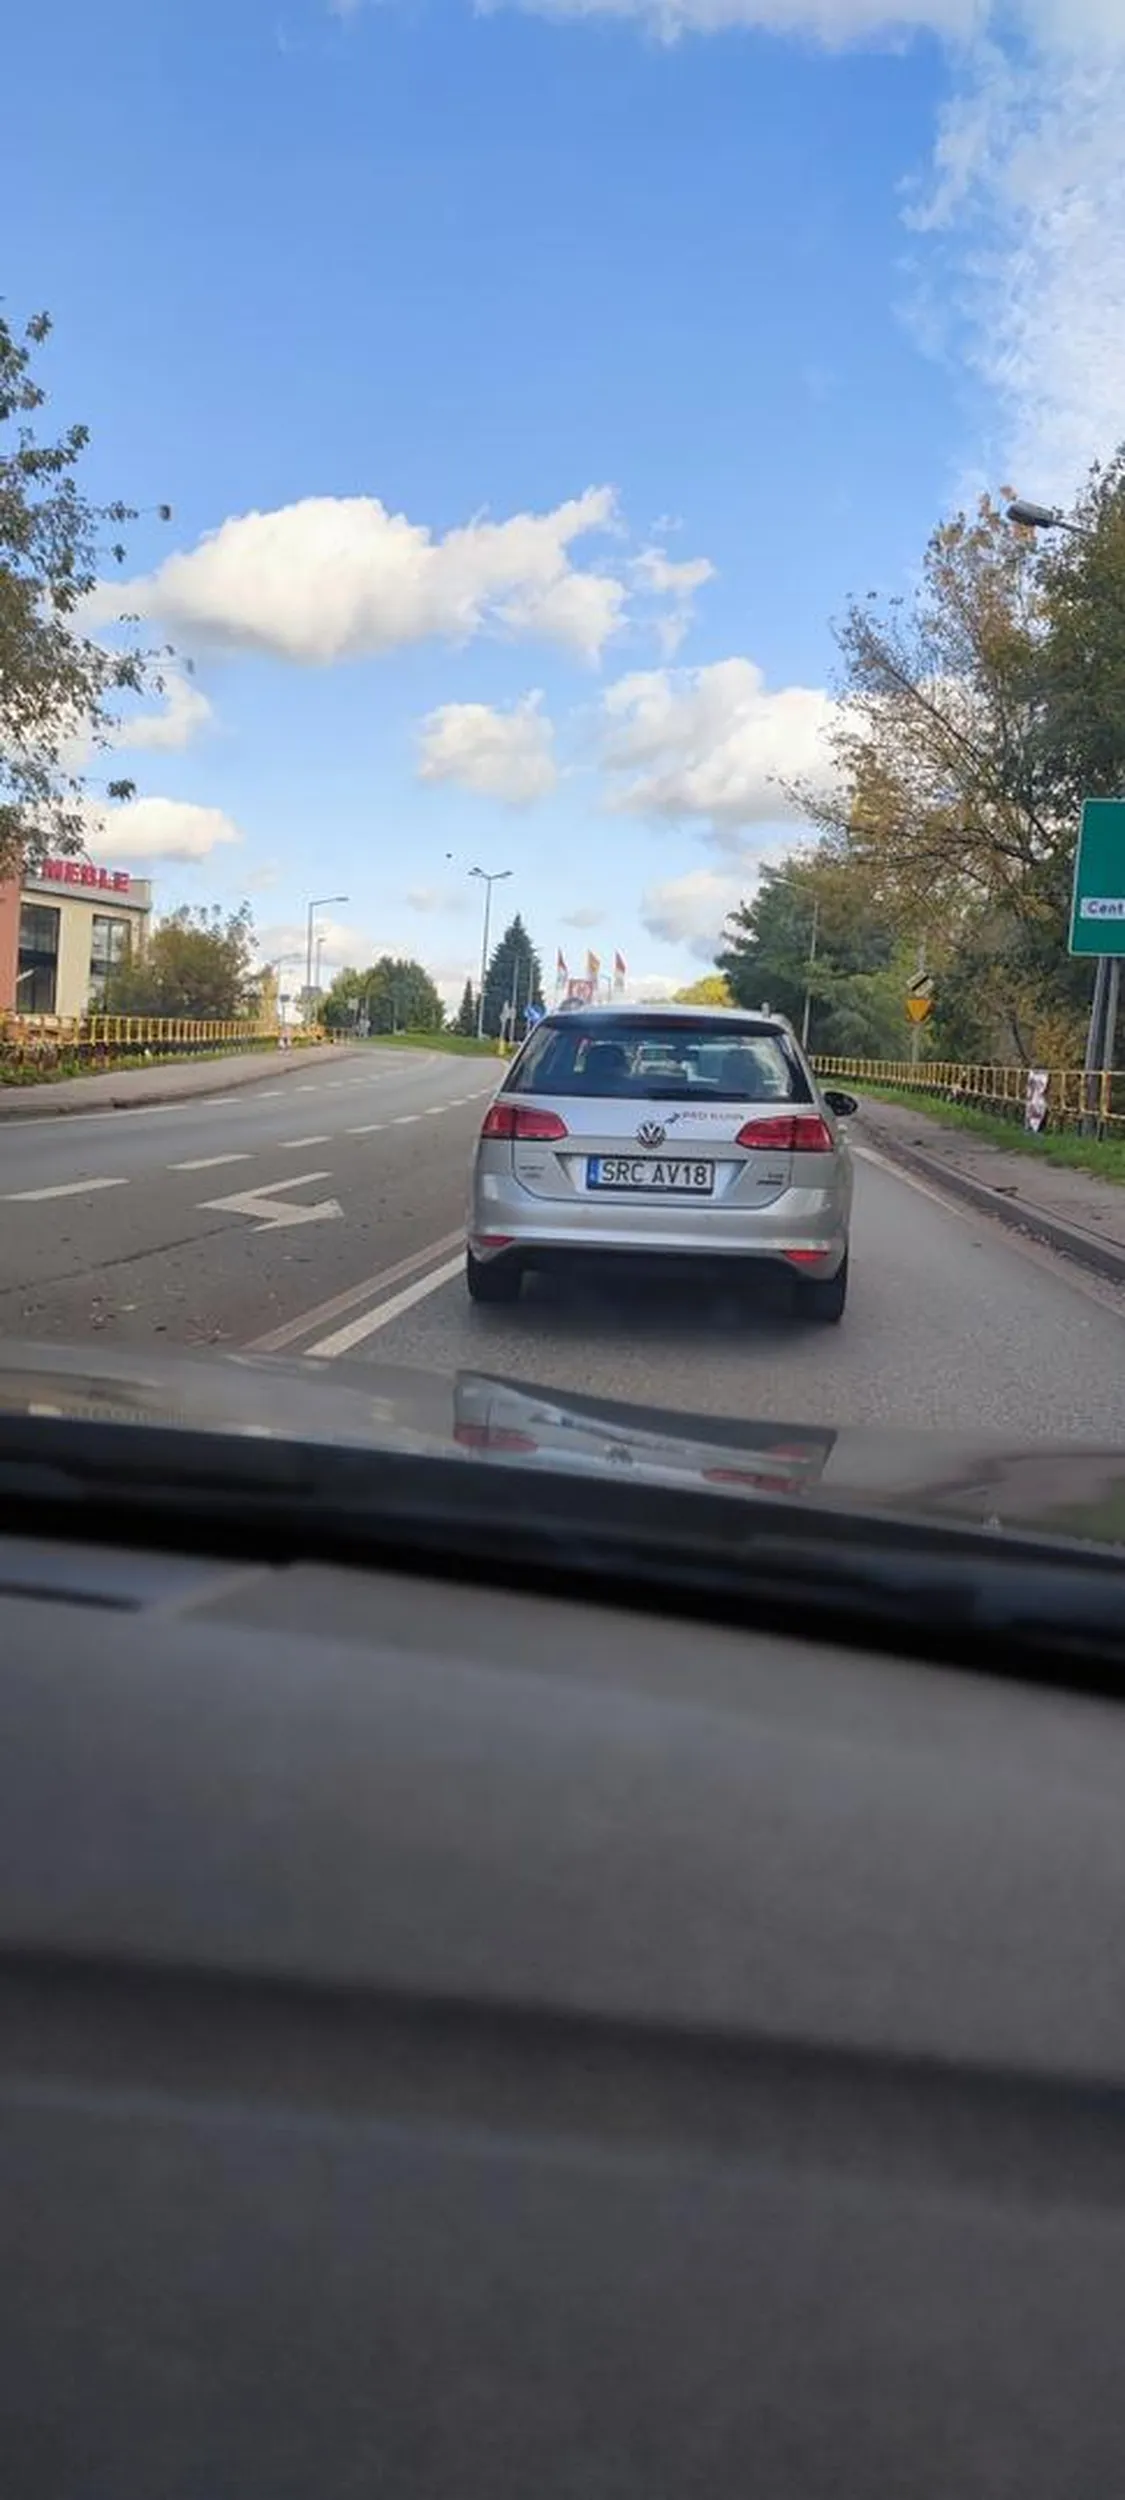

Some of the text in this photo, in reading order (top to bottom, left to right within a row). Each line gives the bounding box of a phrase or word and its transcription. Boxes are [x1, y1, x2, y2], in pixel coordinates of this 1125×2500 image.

[42, 857, 130, 893] MEBLE
[602, 1161, 707, 1185] SRC AV18
